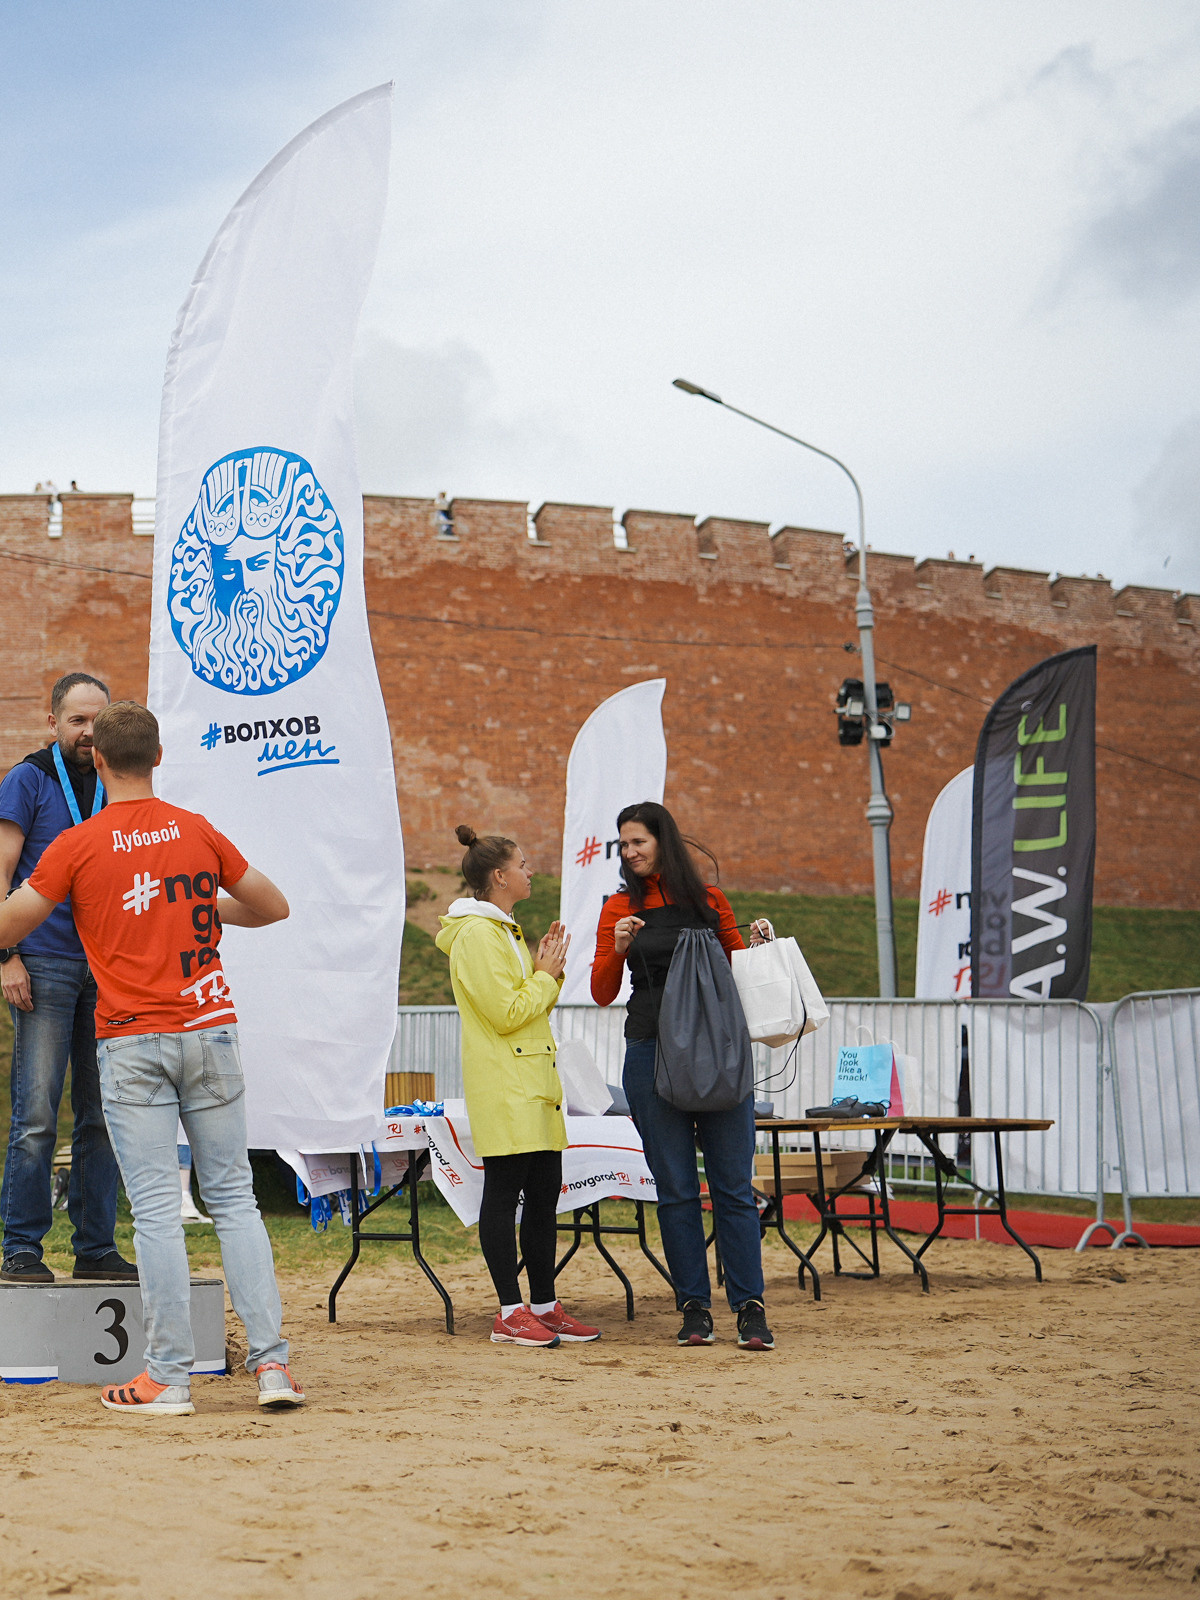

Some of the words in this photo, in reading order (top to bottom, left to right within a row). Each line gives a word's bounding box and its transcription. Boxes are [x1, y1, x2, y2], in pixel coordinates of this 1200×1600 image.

[200, 715, 321, 750] #ВОЛХОВ
[257, 738, 336, 763] мен
[1012, 703, 1069, 852] LIFE
[111, 820, 181, 853] Дубовой
[840, 1058, 859, 1067] look
[842, 1050, 858, 1059] You
[837, 1073, 868, 1082] snack!
[838, 1066, 855, 1074] like
[93, 1298, 129, 1365] 3
